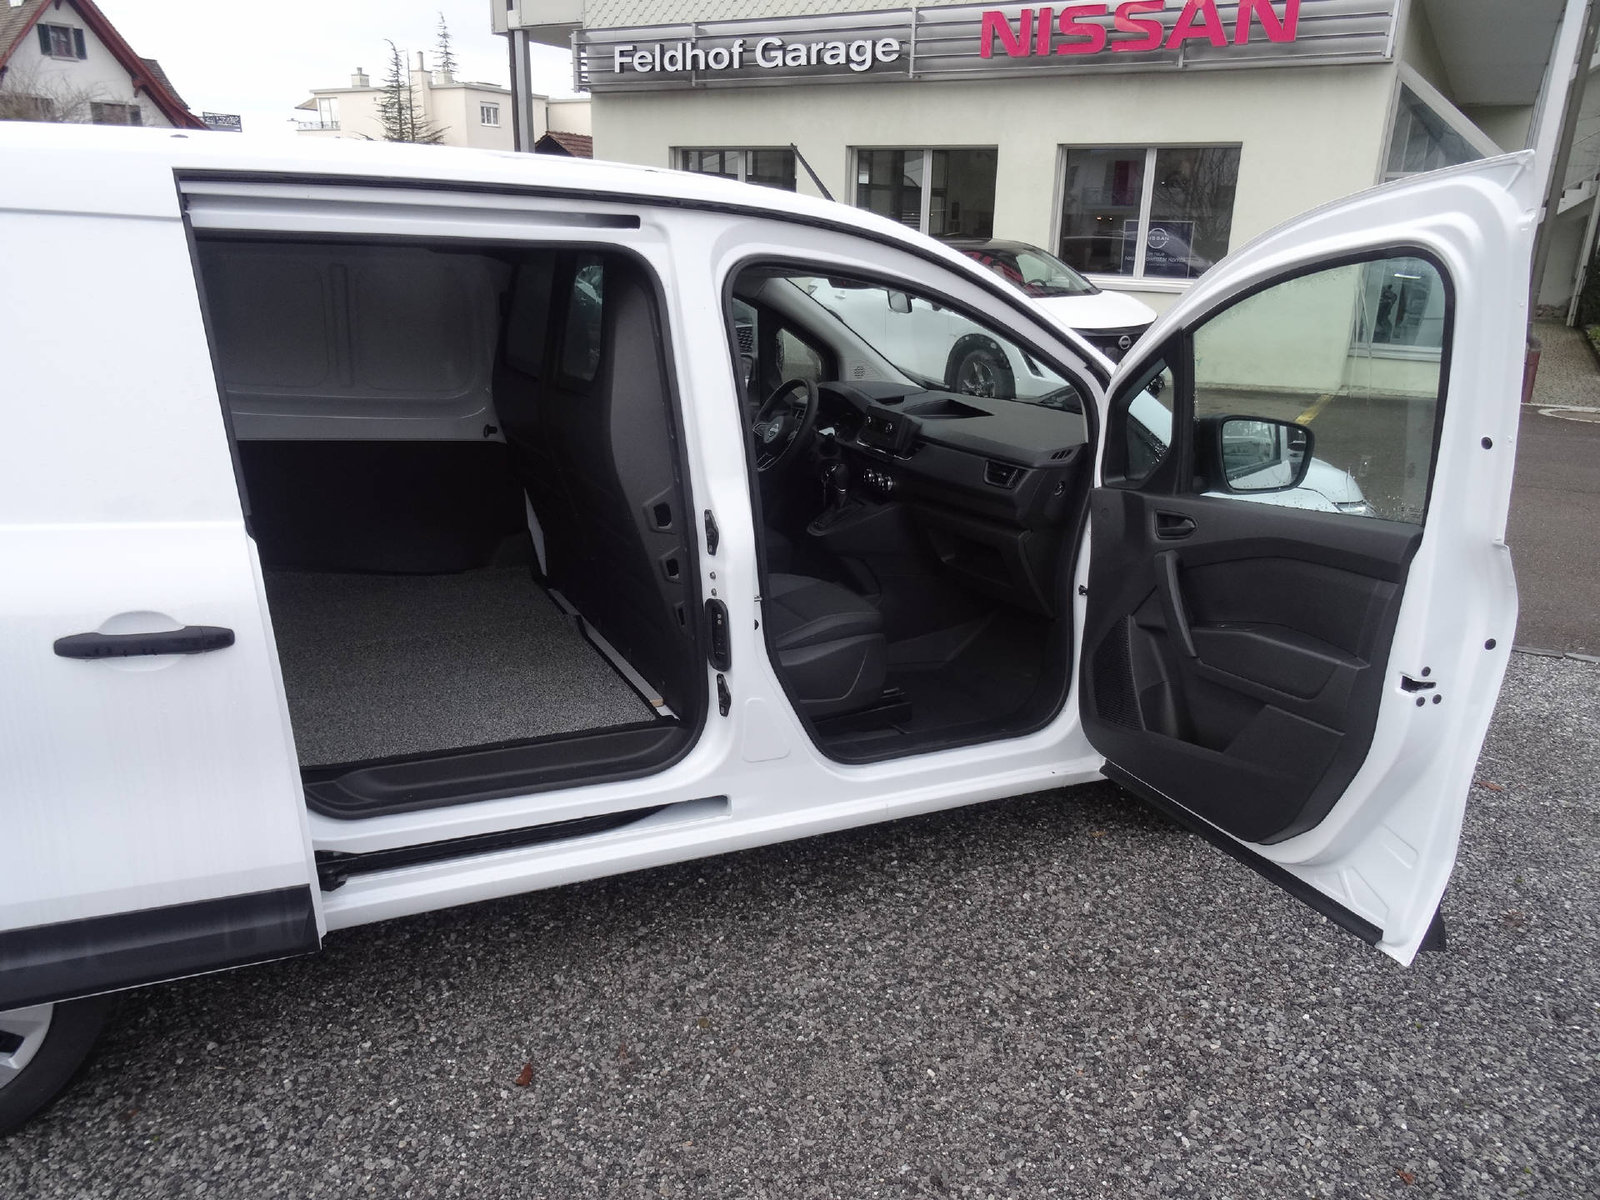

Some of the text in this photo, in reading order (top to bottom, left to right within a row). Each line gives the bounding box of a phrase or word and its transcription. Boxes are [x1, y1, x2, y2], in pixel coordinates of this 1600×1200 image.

[980, 0, 1300, 58] NISSAN
[613, 37, 901, 73] Feldhof Garage
